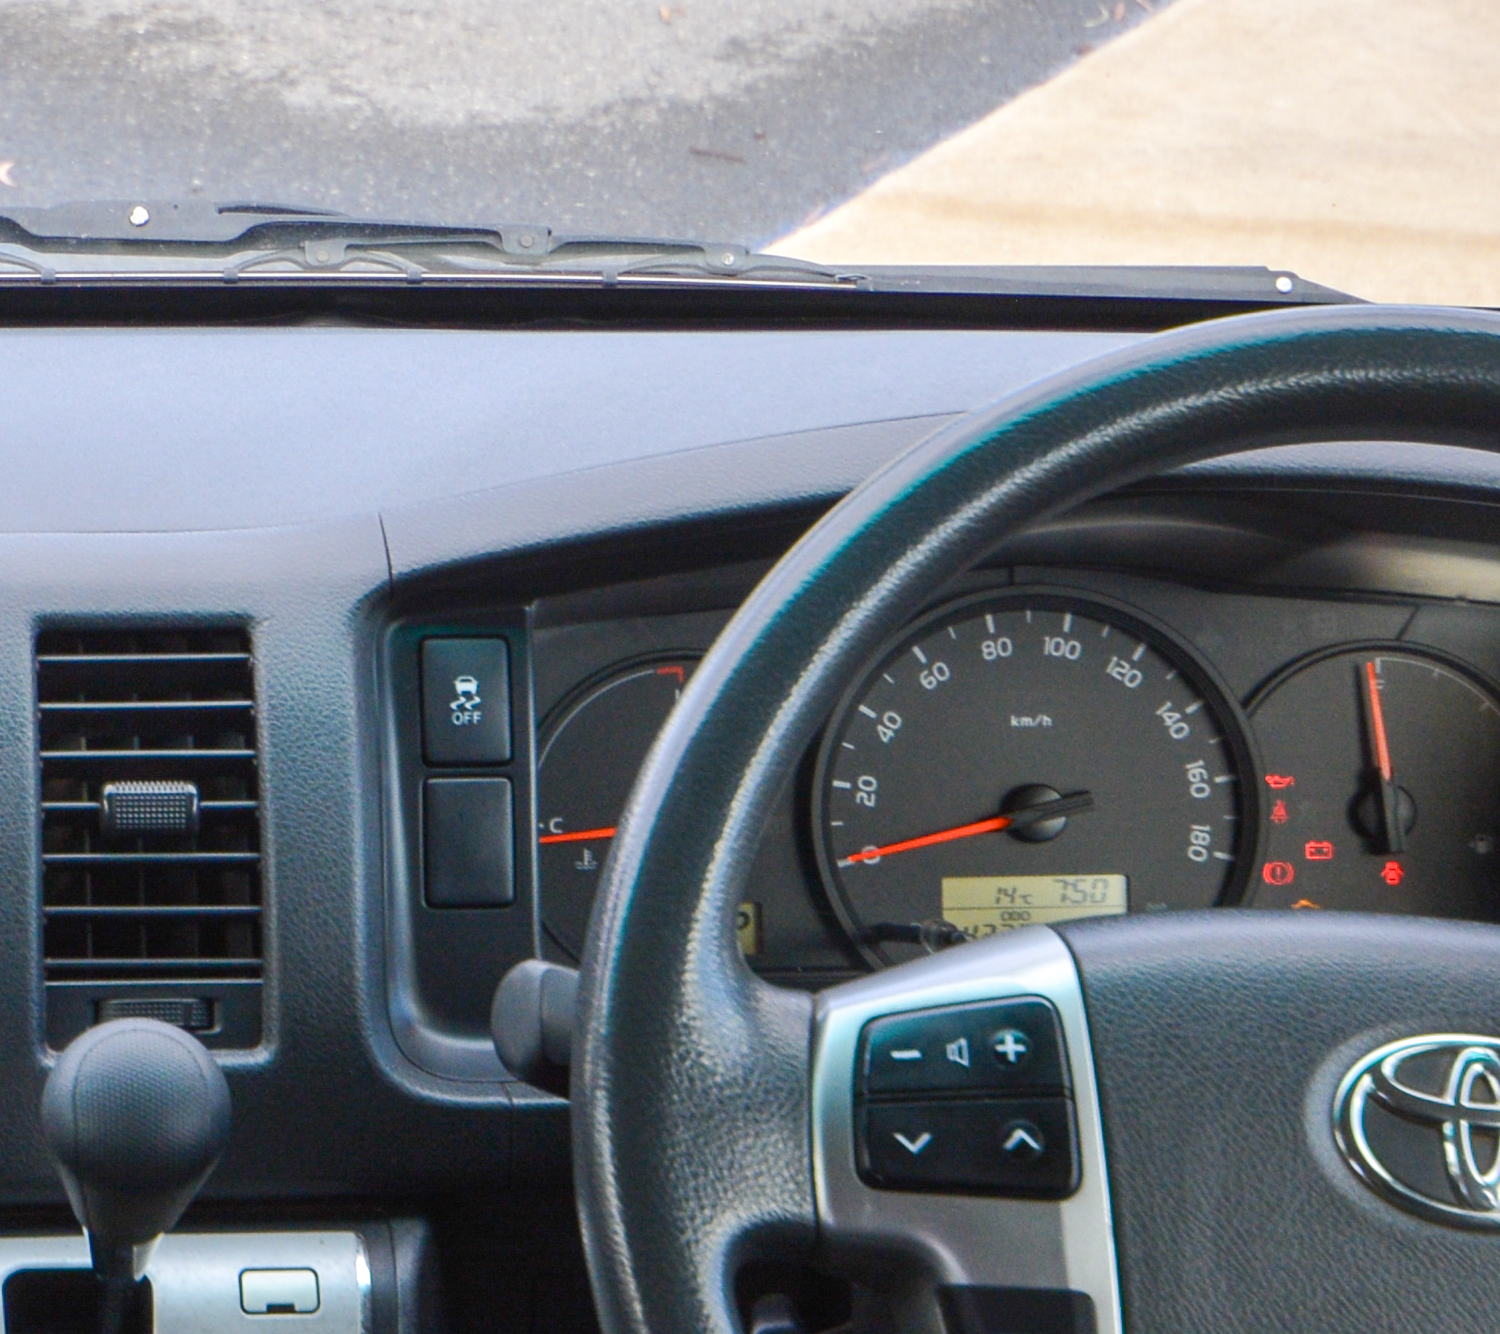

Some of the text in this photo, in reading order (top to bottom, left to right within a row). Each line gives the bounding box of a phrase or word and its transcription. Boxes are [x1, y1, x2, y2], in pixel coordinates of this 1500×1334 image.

[982, 638, 1013, 660] 80
[1043, 636, 1082, 660] 100
[919, 661, 951, 691] 60
[1106, 656, 1142, 688] 120
[452, 712, 482, 725] OFF
[876, 711, 902, 744] 40
[1010, 714, 1053, 728] km/h
[1155, 701, 1190, 740] 140
[856, 775, 878, 808] 20
[1185, 760, 1211, 799] 160
[550, 818, 563, 834] C
[1187, 824, 1211, 862] 180
